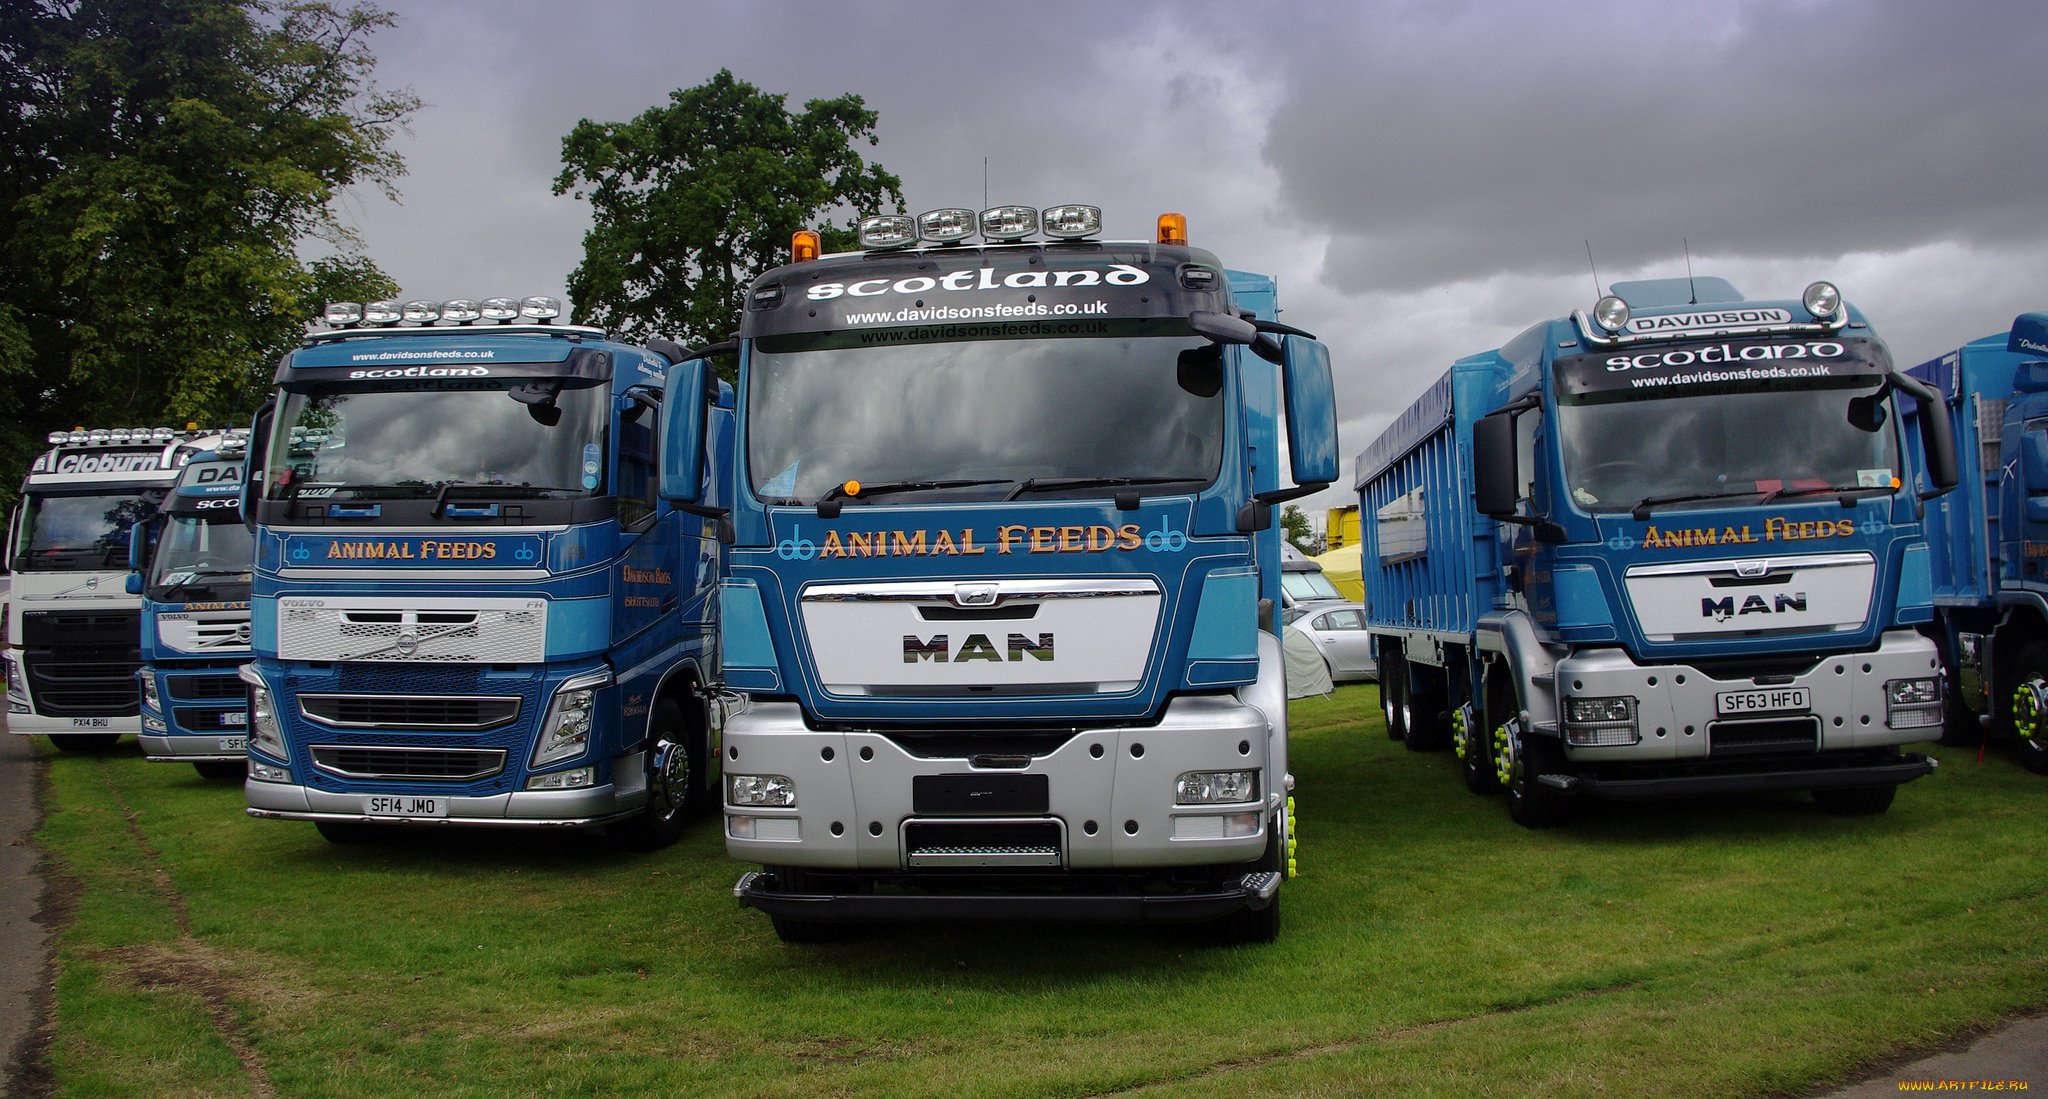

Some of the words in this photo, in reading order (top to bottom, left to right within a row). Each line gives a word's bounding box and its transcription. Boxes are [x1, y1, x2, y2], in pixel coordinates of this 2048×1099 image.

[807, 264, 1150, 300] scotland
[846, 300, 1108, 325] www.davidsonsfeeds.co.uk
[1635, 310, 1781, 330] DAVIDSON
[352, 350, 494, 361] www.davidsonsfeeds.co.uk
[1606, 342, 1844, 372] scotland
[349, 366, 489, 379] scotland
[1631, 364, 1831, 388] www.davidsonsfeeds.co.uk
[57, 453, 159, 473] Cloburn
[197, 465, 243, 483] DA
[818, 528, 986, 560] ANIMAL
[997, 524, 1142, 556] FEEDS
[1642, 526, 1759, 549] ANIMAL
[1765, 517, 1855, 541] FEEDS
[327, 540, 415, 560] ANIMAL
[420, 540, 496, 561] FEEDS
[183, 602, 251, 610] ANIMAL
[527, 600, 543, 608] FH
[1701, 592, 1807, 617] MAN
[903, 633, 1054, 663] MAN
[1725, 694, 1767, 710] SF63
[1771, 692, 1802, 707] HFO
[73, 718, 90, 727] PX14
[371, 798, 402, 812] SF14
[407, 799, 435, 814] JMO
